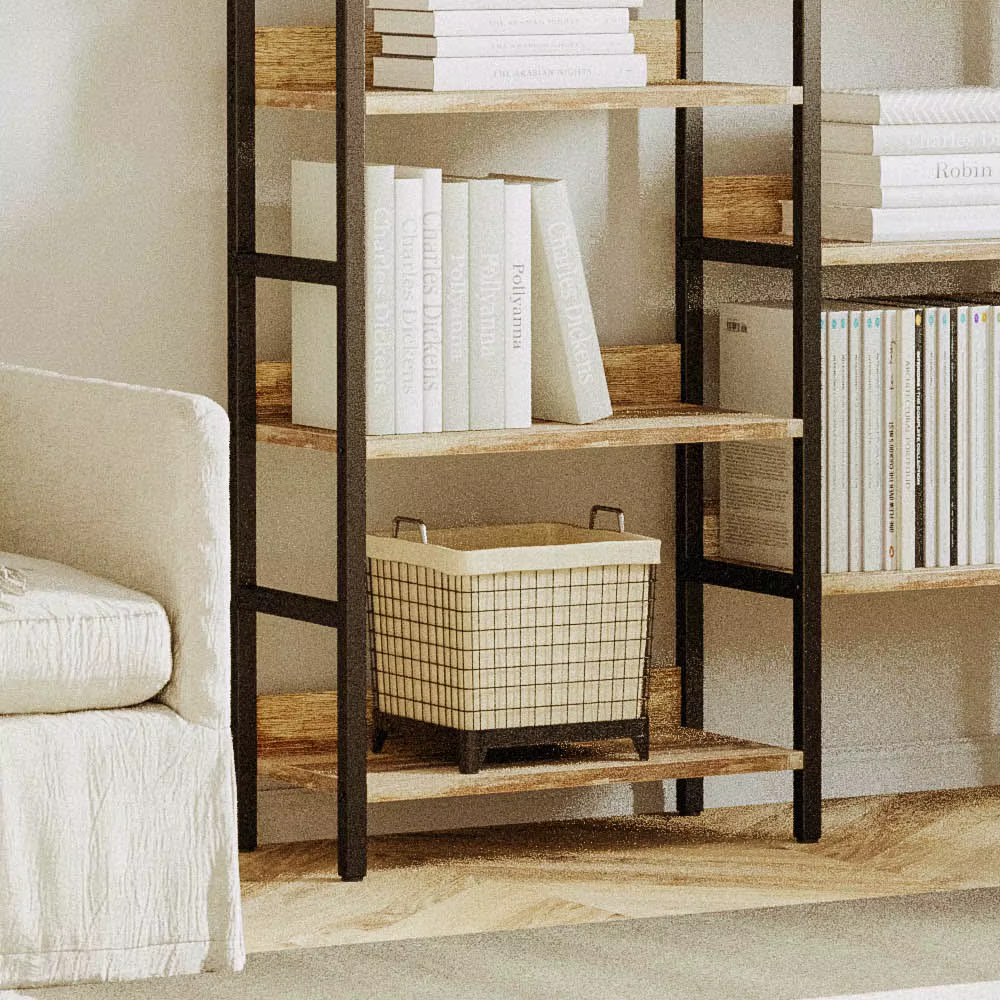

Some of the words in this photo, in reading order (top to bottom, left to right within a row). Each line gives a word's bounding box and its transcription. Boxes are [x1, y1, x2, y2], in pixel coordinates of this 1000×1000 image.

[935, 161, 993, 180] Robin
[401, 218, 418, 301] Charles
[423, 210, 441, 296] Charles
[477, 252, 503, 358] Pollyanna
[509, 263, 525, 350] Pollyanna
[547, 221, 581, 302] Charles
[566, 304, 596, 386] Dickens
[401, 308, 418, 395] Dickens
[423, 303, 441, 393] Dickens
